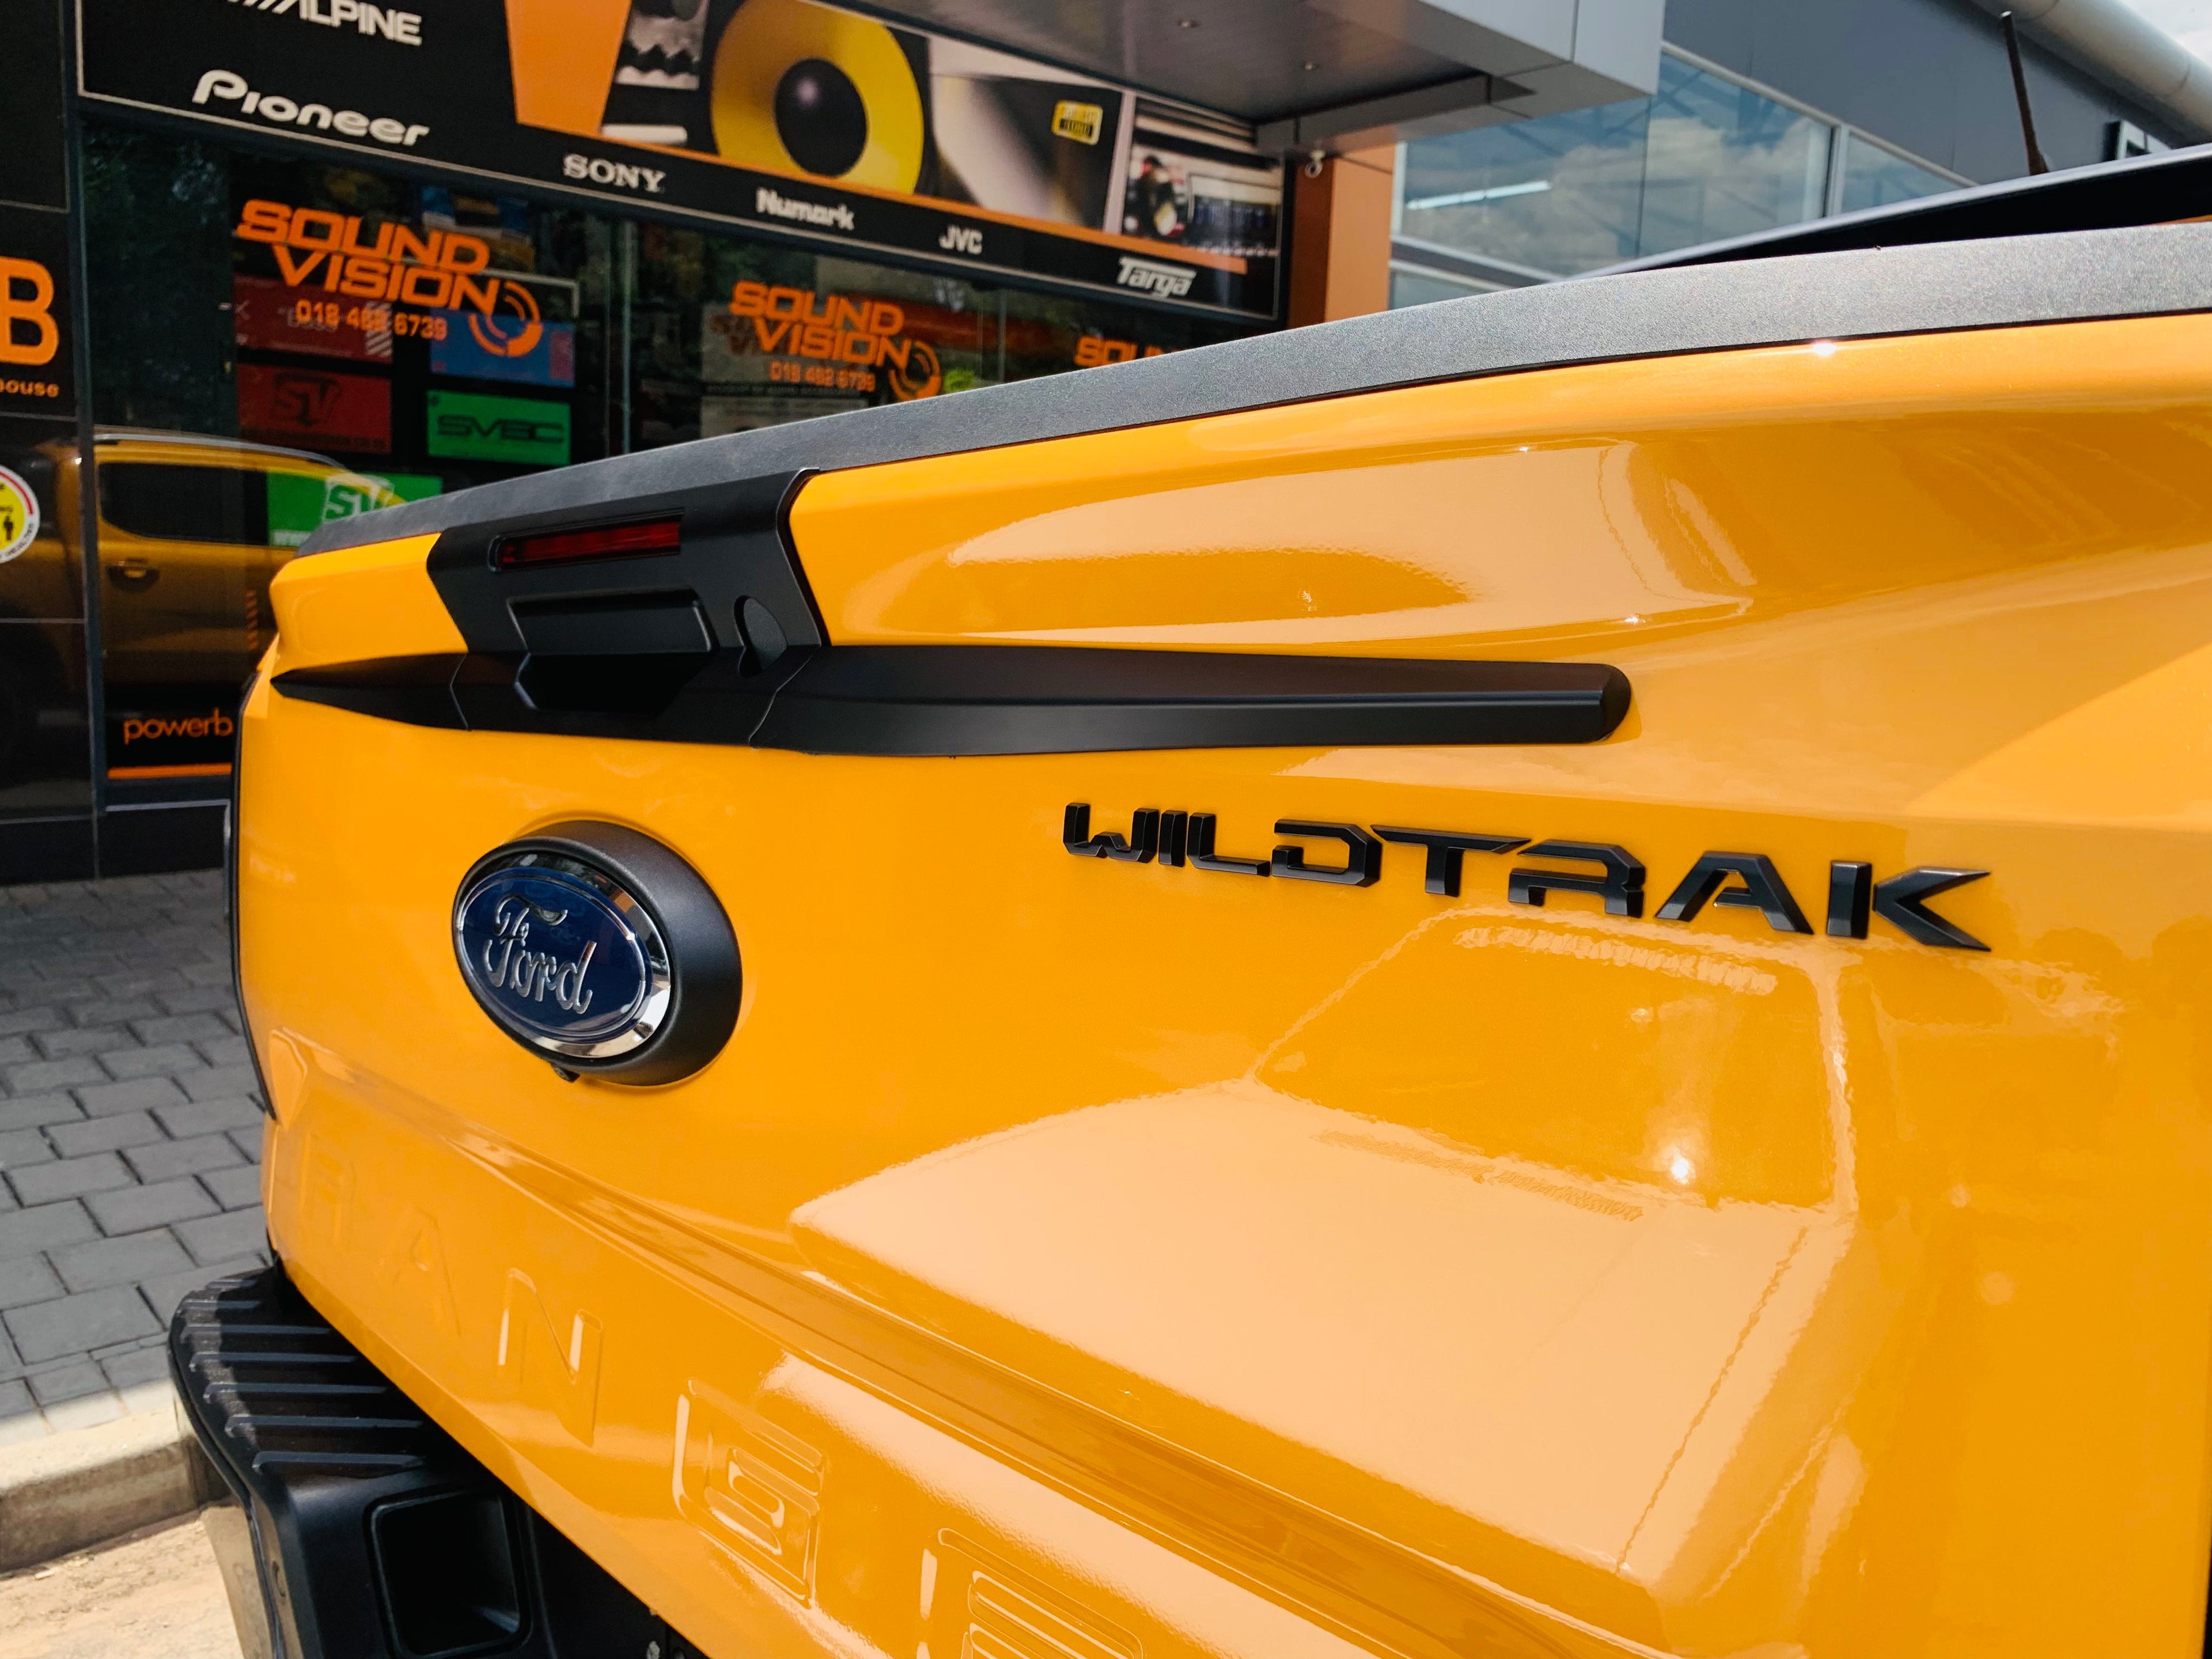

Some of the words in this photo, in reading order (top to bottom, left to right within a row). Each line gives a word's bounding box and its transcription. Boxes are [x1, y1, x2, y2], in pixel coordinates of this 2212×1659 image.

[191, 69, 430, 146] Pioneer
[563, 153, 666, 194] SONY
[756, 188, 855, 230] Numark
[237, 199, 491, 275] SOUND
[939, 225, 983, 255] JVC
[270, 242, 501, 316] VISION
[1116, 256, 1197, 299] Targa
[295, 299, 340, 328] 018
[728, 280, 905, 336] SOUND
[752, 316, 913, 370] VISION
[123, 706, 234, 745] powerb
[1063, 801, 1993, 952] WILDTRAK
[483, 893, 597, 1015] Ford
